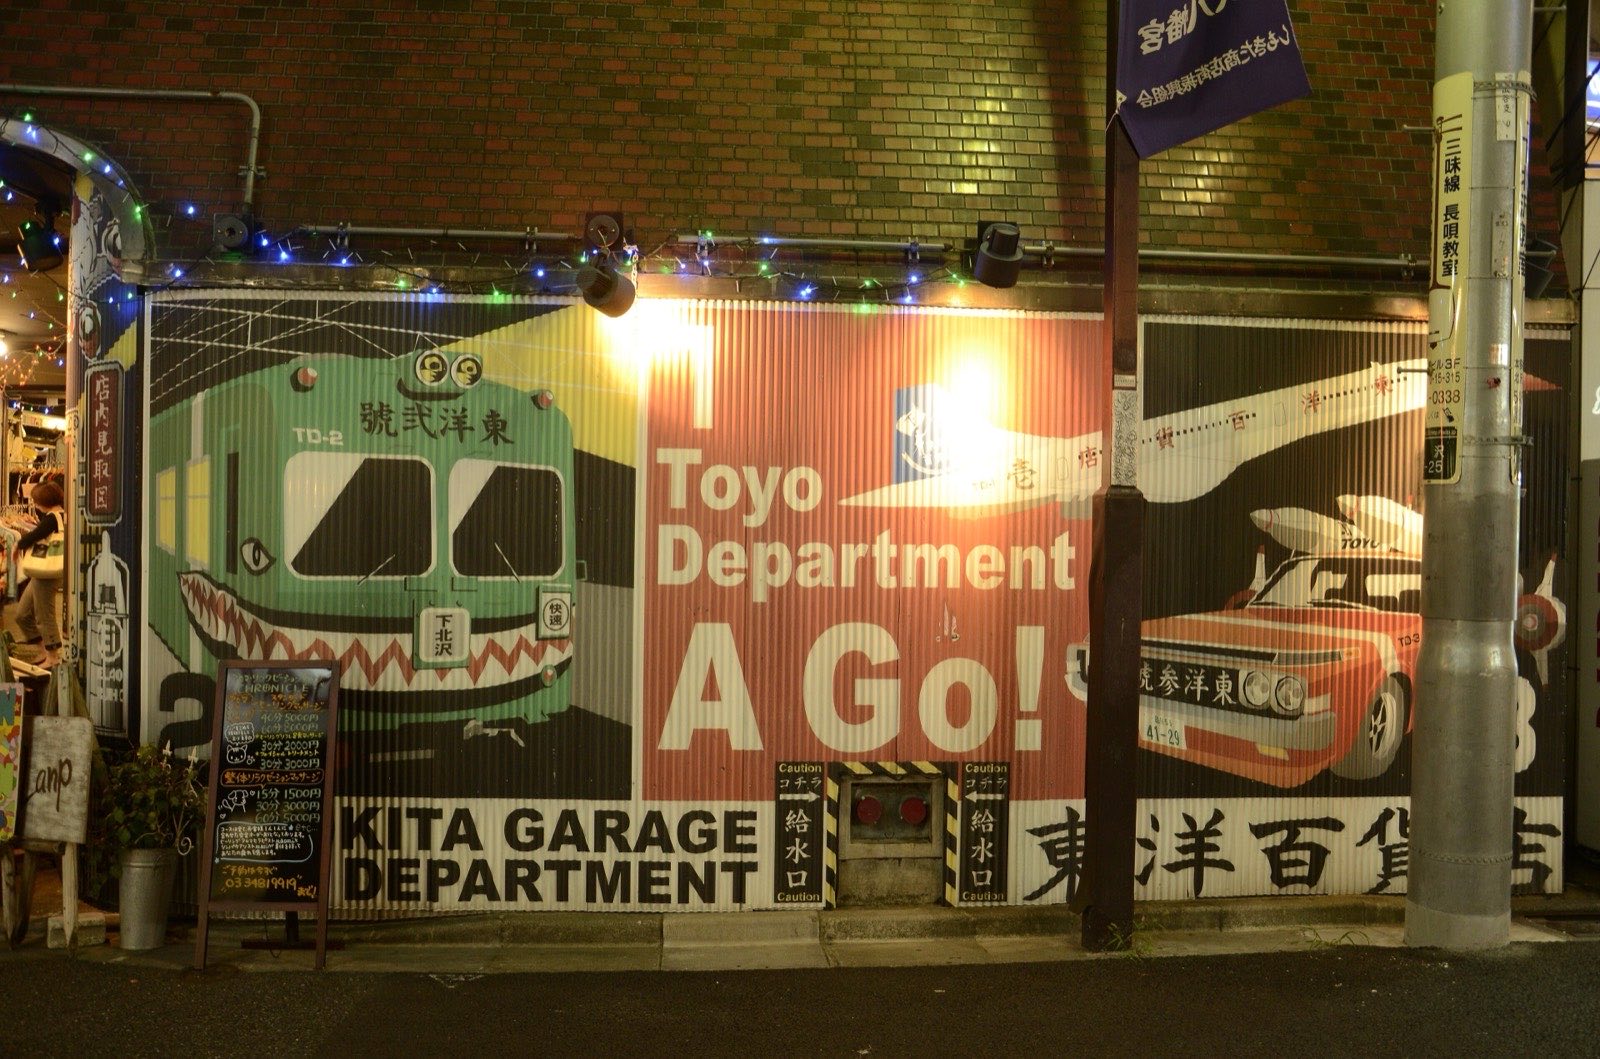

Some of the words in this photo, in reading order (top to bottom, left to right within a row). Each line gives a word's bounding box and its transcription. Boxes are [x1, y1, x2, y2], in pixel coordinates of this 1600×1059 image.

[292, 427, 344, 446] TD-2
[656, 448, 823, 528] Toyo
[657, 524, 1076, 603] Department
[549, 603, 563, 626] 快速
[434, 614, 453, 657] 下北沢
[657, 622, 764, 751] A
[802, 622, 1045, 754] Go!
[1146, 724, 1181, 746] 41-29
[261, 740, 282, 752] 30分
[285, 740, 319, 751] 2000円
[260, 758, 283, 770] 30分
[284, 758, 320, 769] 3000円
[779, 763, 822, 774] Caution
[965, 763, 1008, 774] Caution
[779, 776, 822, 789] コチラ
[965, 776, 1008, 789] コチラ
[257, 788, 280, 800] 15分
[284, 788, 321, 800] 1500円
[256, 801, 280, 812] 30分
[283, 801, 320, 812] 3000円
[341, 806, 484, 851] KITA
[503, 808, 758, 854] GARAGE
[784, 808, 812, 888] 給水口
[970, 808, 997, 888] 給水口
[344, 857, 758, 905] DEPARTMENT
[777, 891, 820, 902] Caution
[962, 891, 1004, 902] Caution
